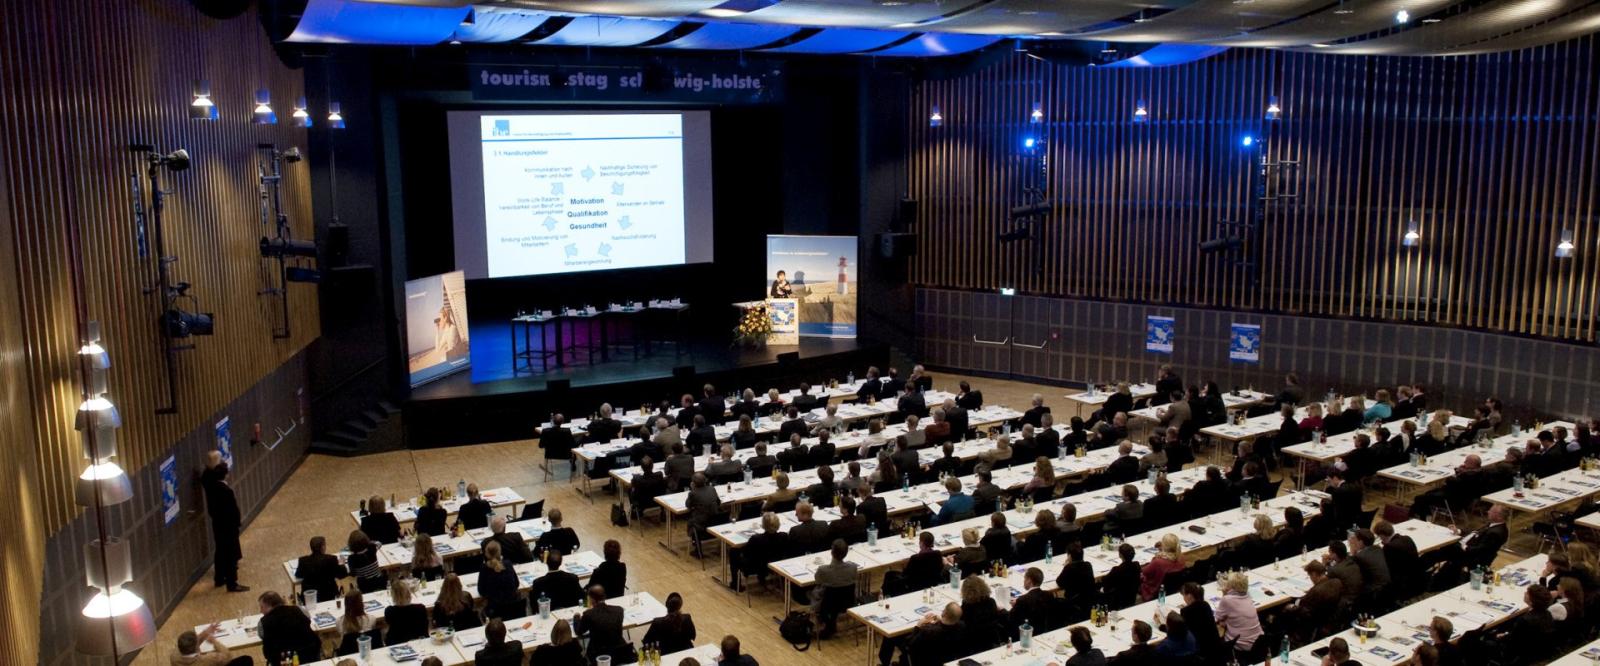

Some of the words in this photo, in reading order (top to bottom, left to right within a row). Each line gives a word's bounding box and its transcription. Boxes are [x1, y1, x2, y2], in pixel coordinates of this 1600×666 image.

[570, 197, 605, 205] Motivation
[567, 209, 608, 218] Qualifikation
[569, 222, 607, 230] Gesundheit
